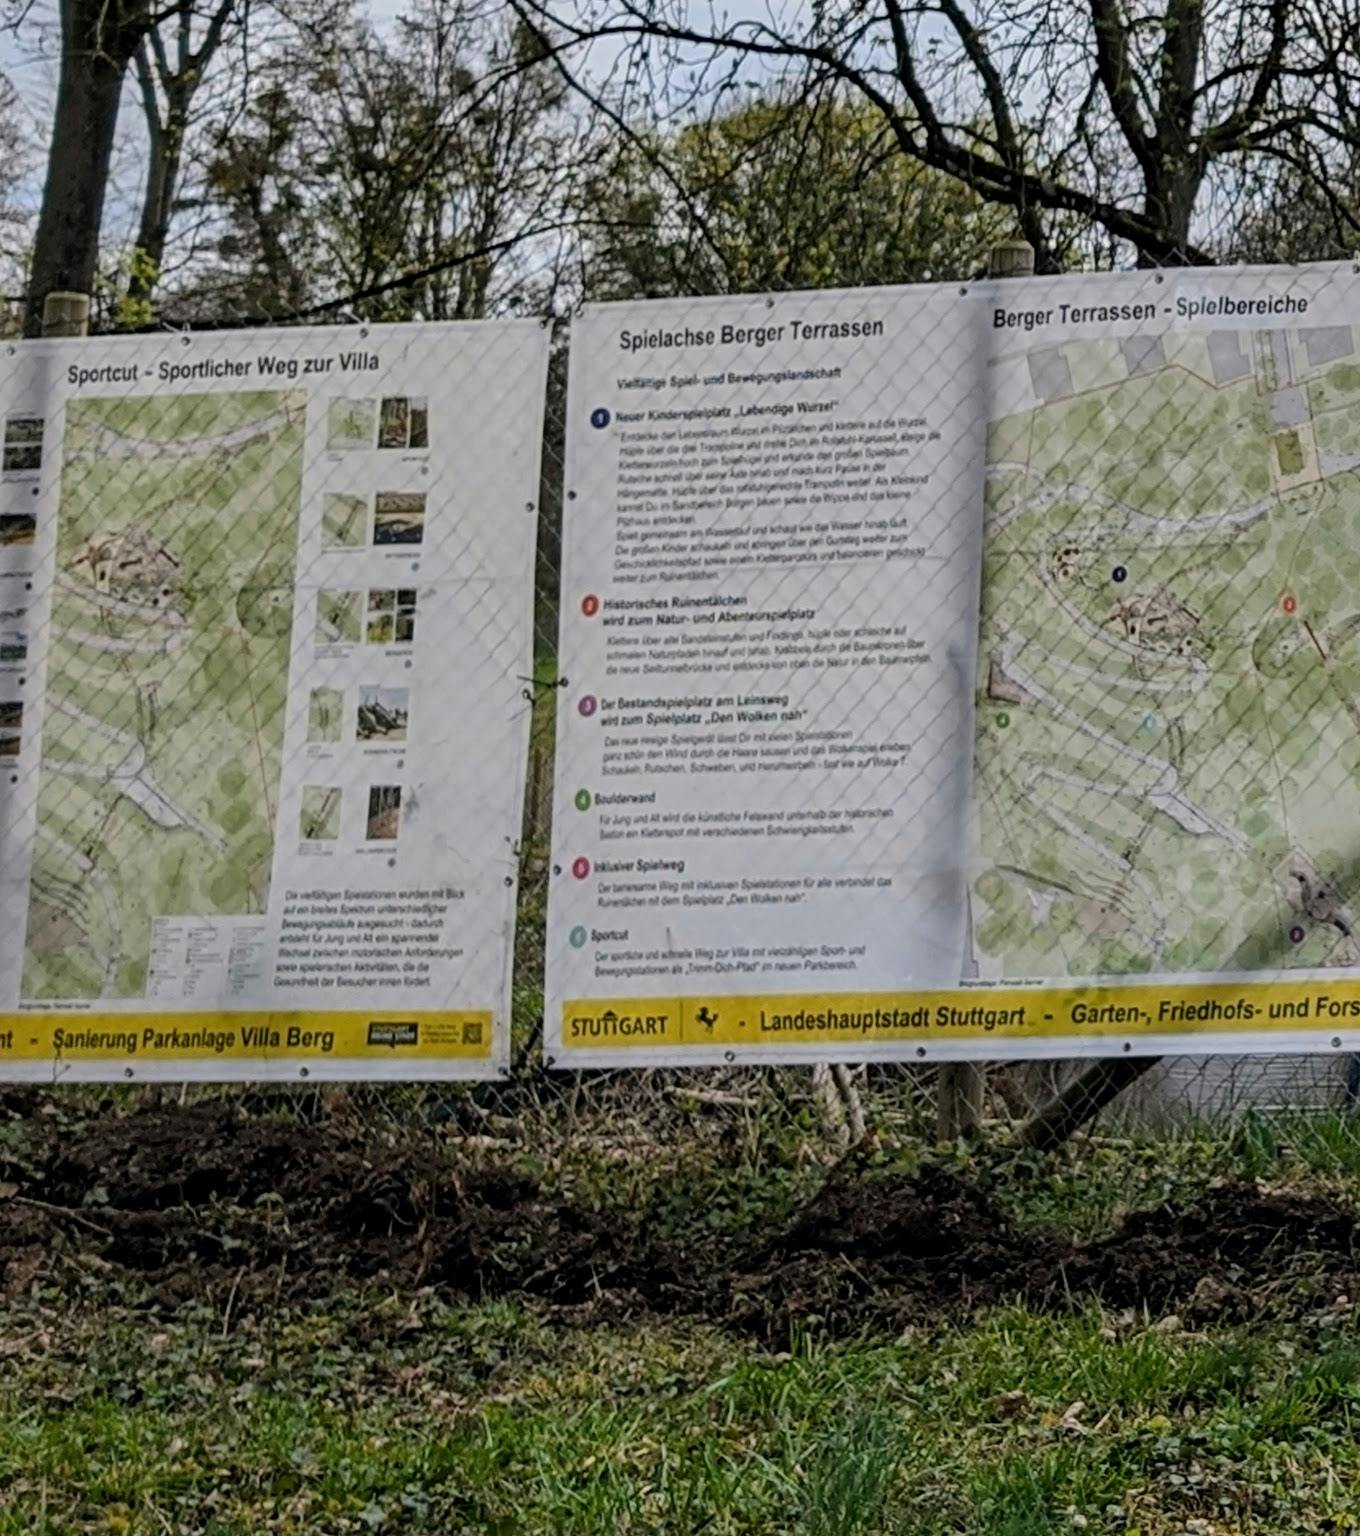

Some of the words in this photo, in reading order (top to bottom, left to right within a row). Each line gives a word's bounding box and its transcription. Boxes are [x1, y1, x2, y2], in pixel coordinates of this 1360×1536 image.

[993, 308, 1052, 329] Berger
[1059, 305, 1155, 323] Terrassen
[1176, 294, 1307, 321] Spielbereiche
[620, 327, 714, 353] Spielachse
[720, 325, 783, 346] Berger
[790, 321, 883, 339] Terrassen
[68, 363, 138, 386] Sportcut
[159, 358, 251, 382] Sportlicher
[257, 356, 297, 377] Weg
[303, 358, 333, 372] zur
[338, 352, 379, 370] Villa
[670, 375, 701, 388] Spiel-
[703, 373, 724, 384] und
[727, 367, 841, 384] Bewegungslandschaft
[615, 412, 645, 422] Neuer
[648, 407, 730, 421] Kinderspielplatz
[602, 597, 667, 609] Historisches
[672, 595, 747, 606] Ruinentälchen
[602, 615, 624, 626] wird
[628, 616, 652, 625] zum
[656, 614, 689, 624] Natur-
[692, 612, 714, 622] und
[717, 609, 815, 623] Abenteuerspielplatz
[601, 699, 615, 709] Der
[618, 696, 711, 710] Bestandspielplatz
[716, 698, 733, 706] am
[737, 695, 788, 707] Leinsweg
[600, 715, 617, 725] wird
[621, 716, 643, 724] zum
[646, 713, 701, 727] Spielplatz
[737, 711, 777, 721] Wolken
[594, 792, 655, 805] Boulderwand
[636, 859, 684, 873] Spielweg
[590, 930, 628, 944] Sportcut
[571, 1008, 667, 1037] STUTTGART
[760, 1006, 929, 1033] Landeshauptstadt
[936, 1004, 1024, 1029] Stuttgart
[1071, 1002, 1151, 1024] Garten-,
[1158, 998, 1261, 1019] Friedhofs-
[1269, 997, 1304, 1017] und
[53, 1027, 136, 1052] Sanierung
[143, 1026, 235, 1052] Parkanlage
[240, 1026, 280, 1046] Villa
[286, 1026, 333, 1051] Berg
